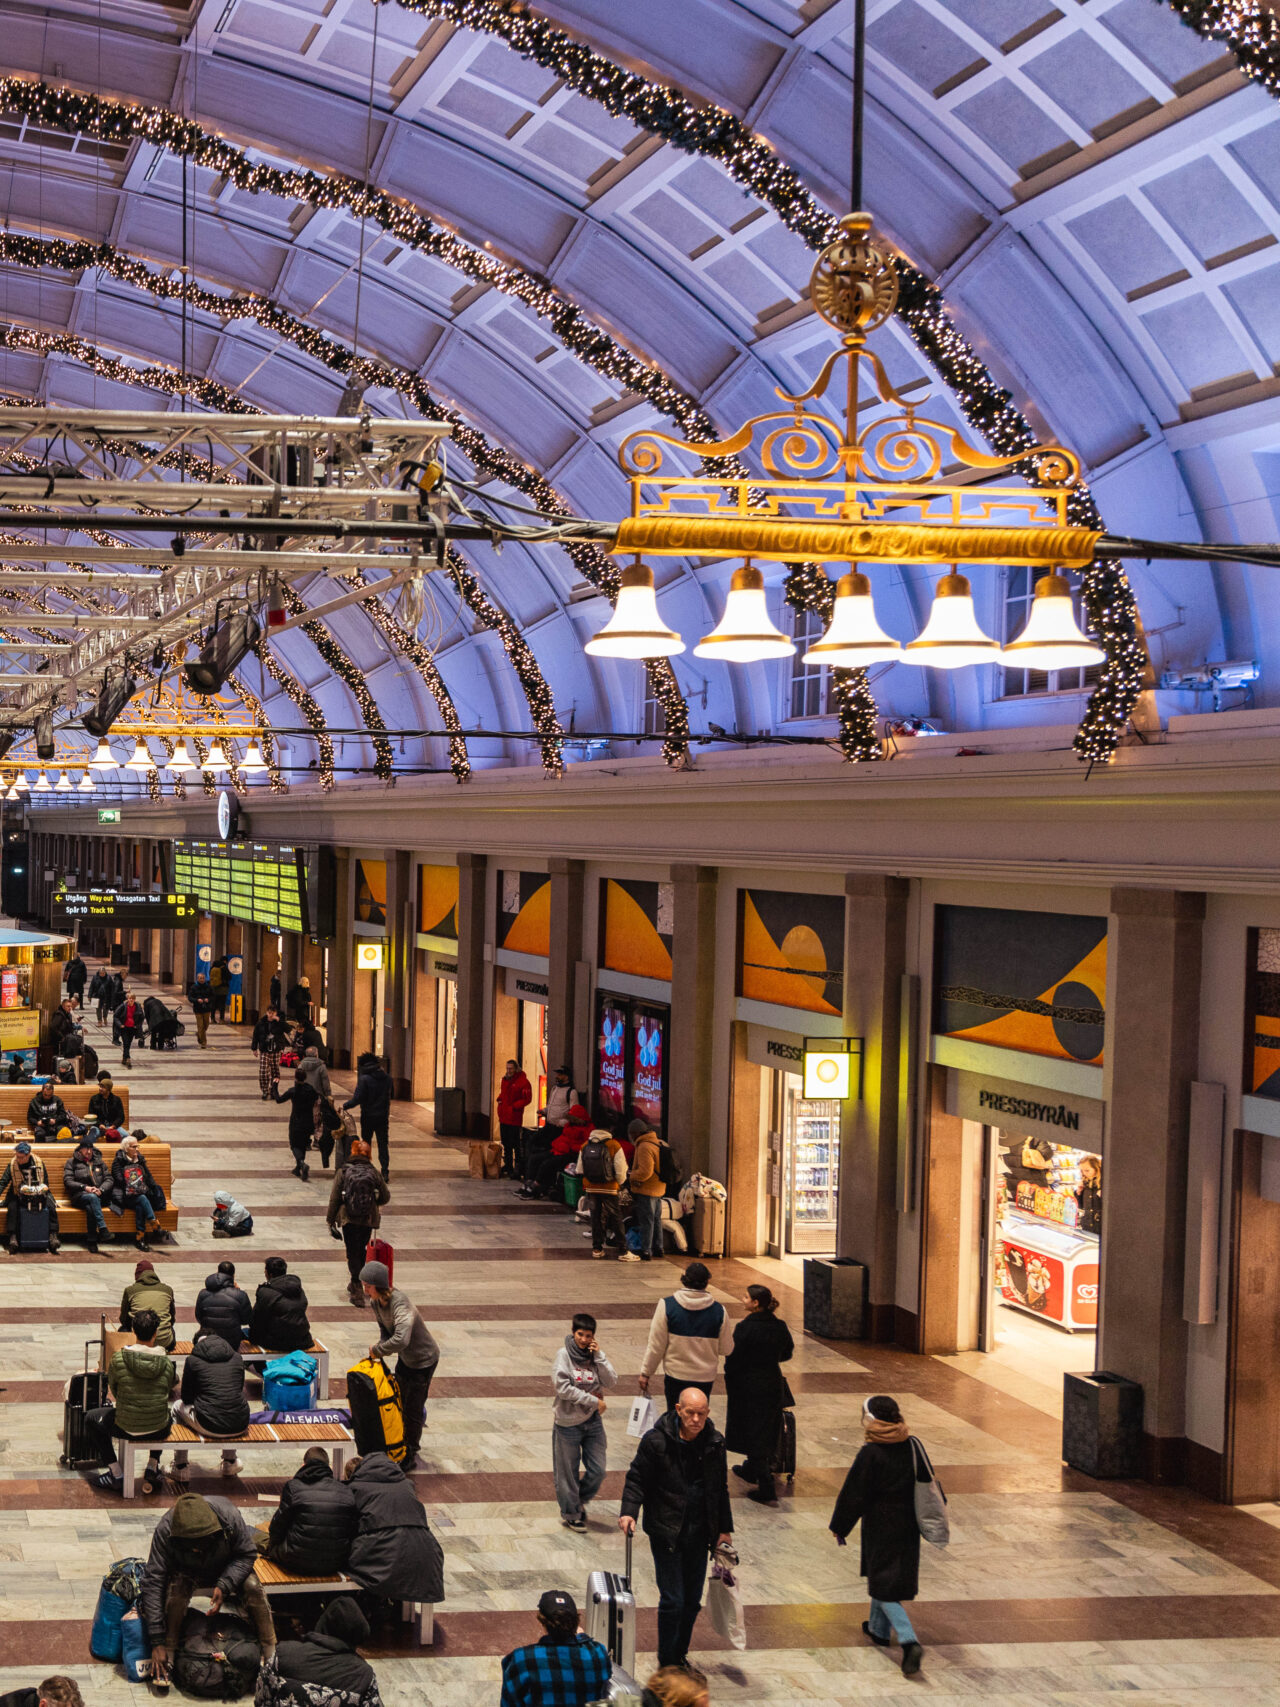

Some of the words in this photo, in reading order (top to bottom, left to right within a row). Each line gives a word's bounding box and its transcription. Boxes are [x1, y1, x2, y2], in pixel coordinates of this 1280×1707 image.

[66, 894, 86, 903] Utgång
[66, 906, 79, 915] Spår
[768, 1041, 803, 1062] PRESS
[603, 1061, 616, 1076] God
[615, 1064, 624, 1079] jul
[638, 1072, 651, 1087] God
[651, 1076, 662, 1091] jul
[980, 1090, 1079, 1130] PRESSBYRÅN
[285, 1414, 340, 1424] ALEWALDS
